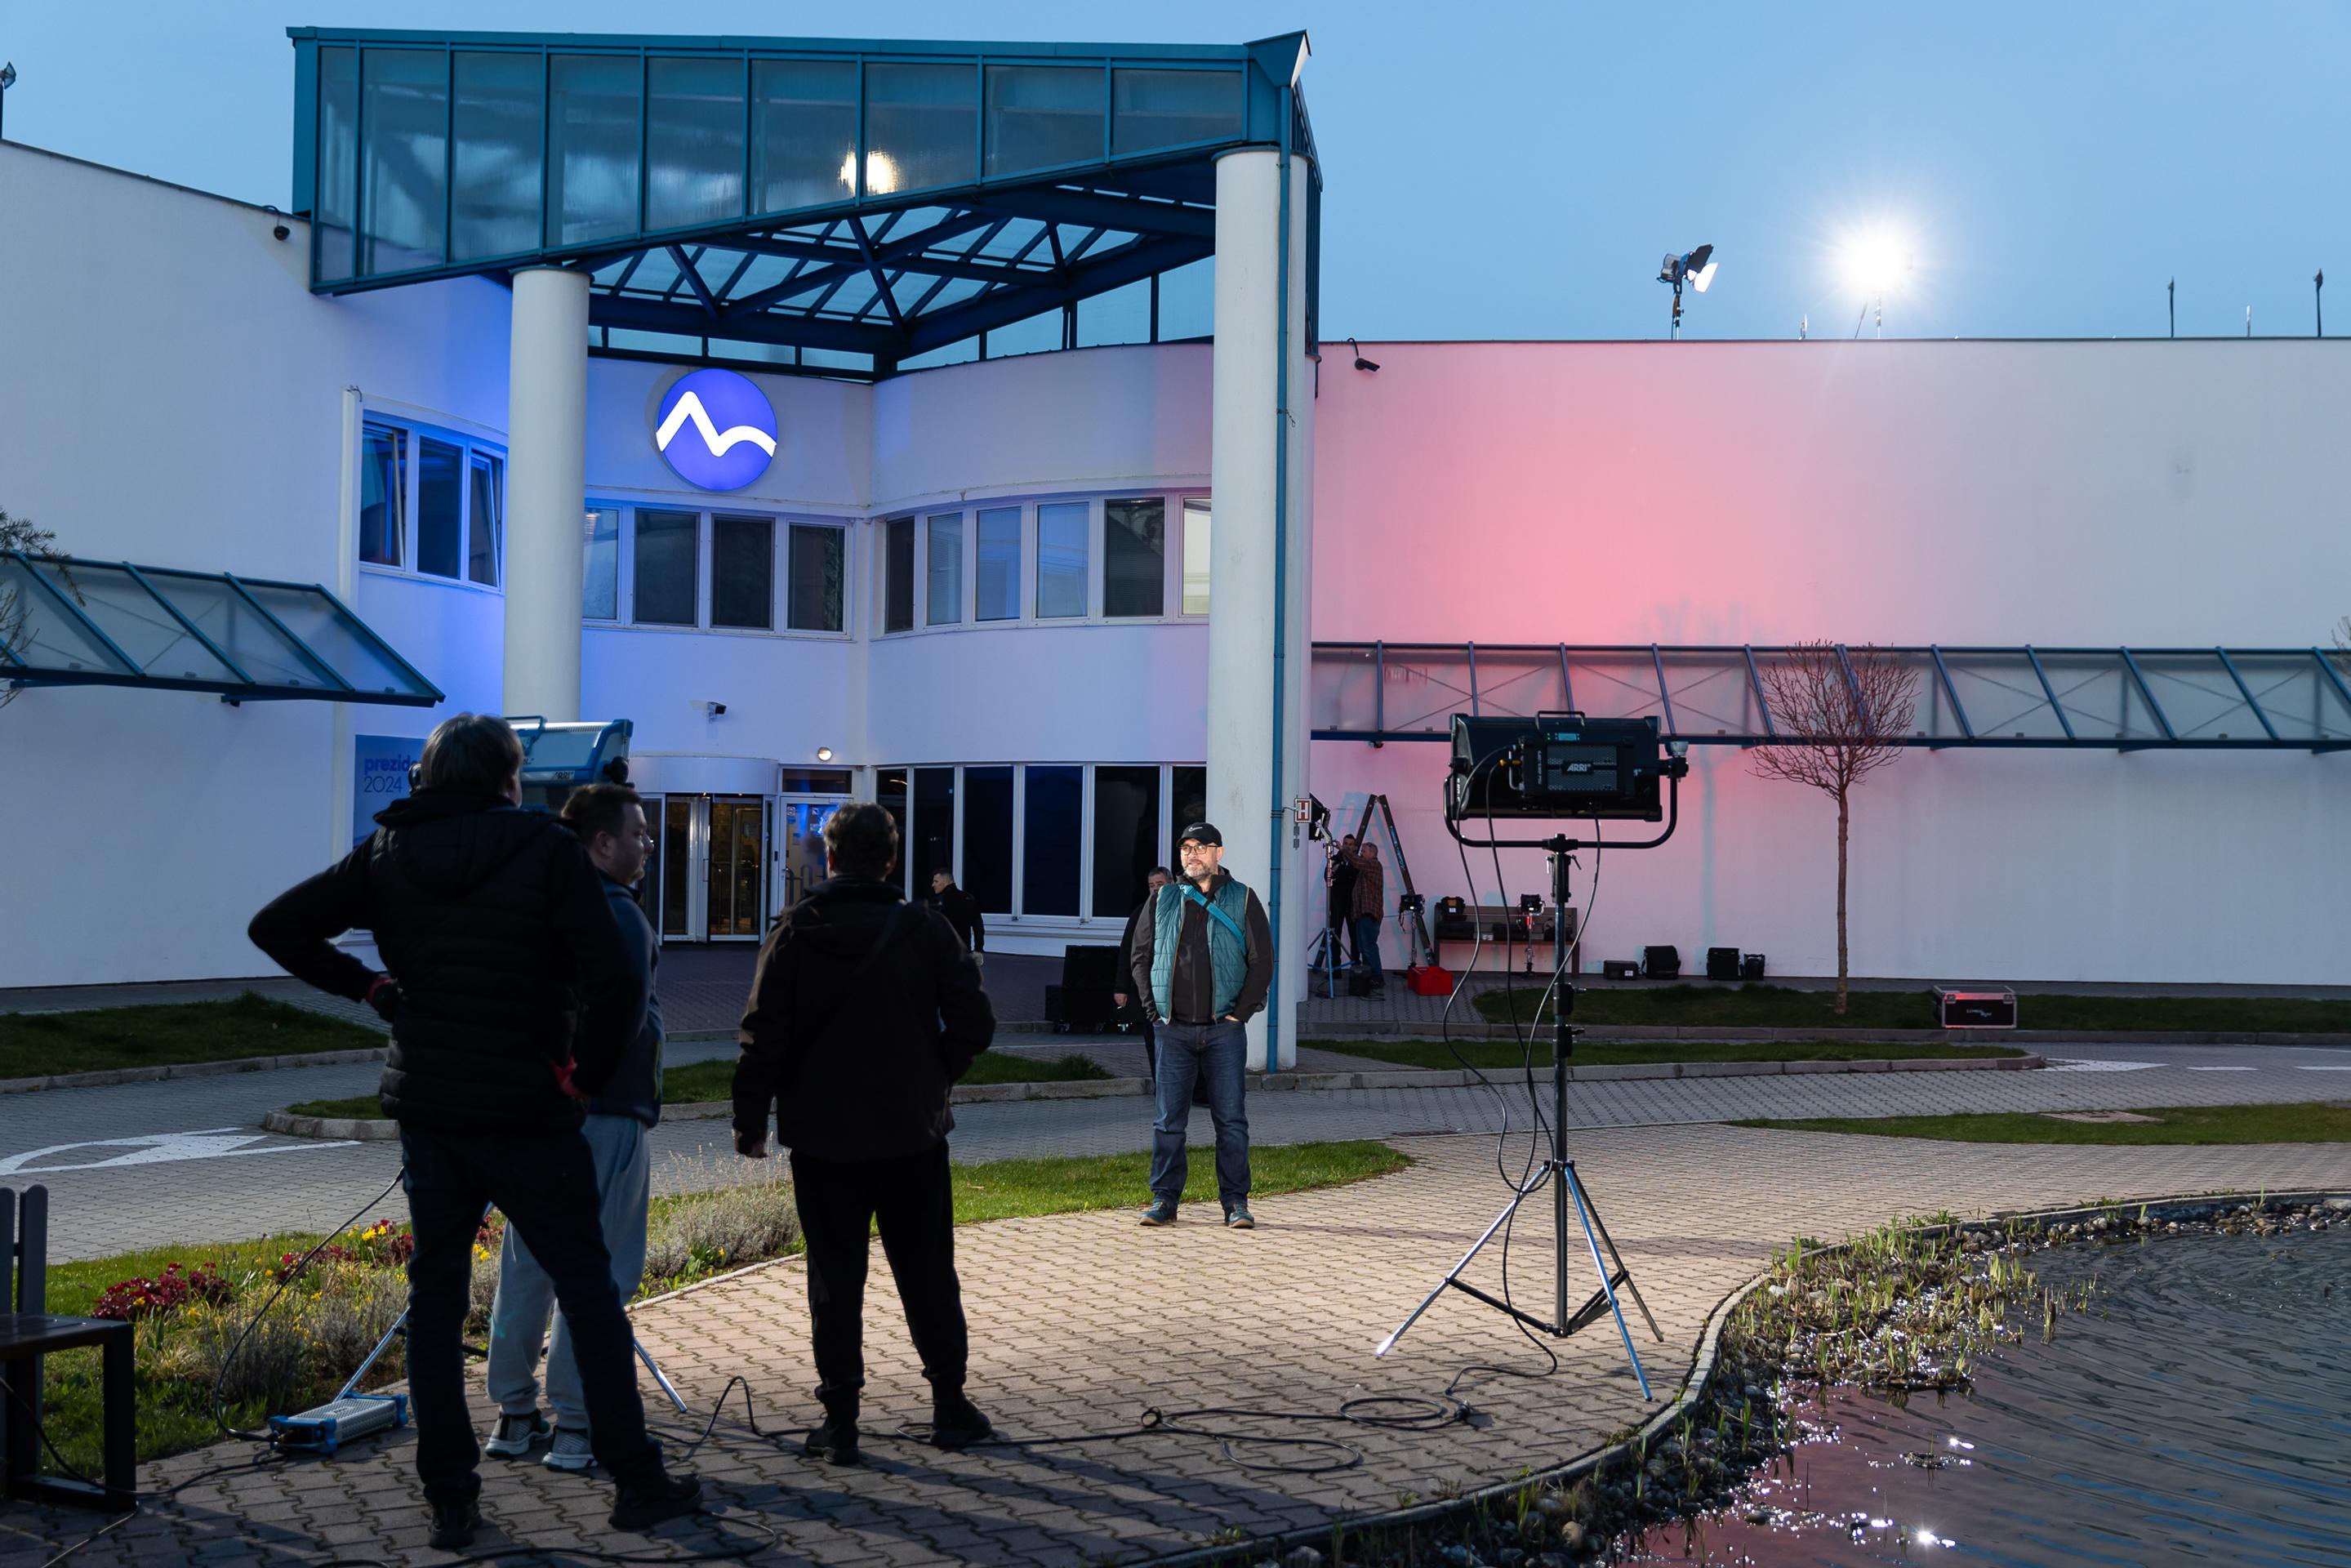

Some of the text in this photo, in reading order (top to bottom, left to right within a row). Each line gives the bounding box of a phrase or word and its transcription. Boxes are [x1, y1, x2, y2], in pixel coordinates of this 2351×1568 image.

[1567, 763, 1588, 772] ARRI
[363, 776, 403, 793] 2024
[1297, 801, 1309, 820] H
